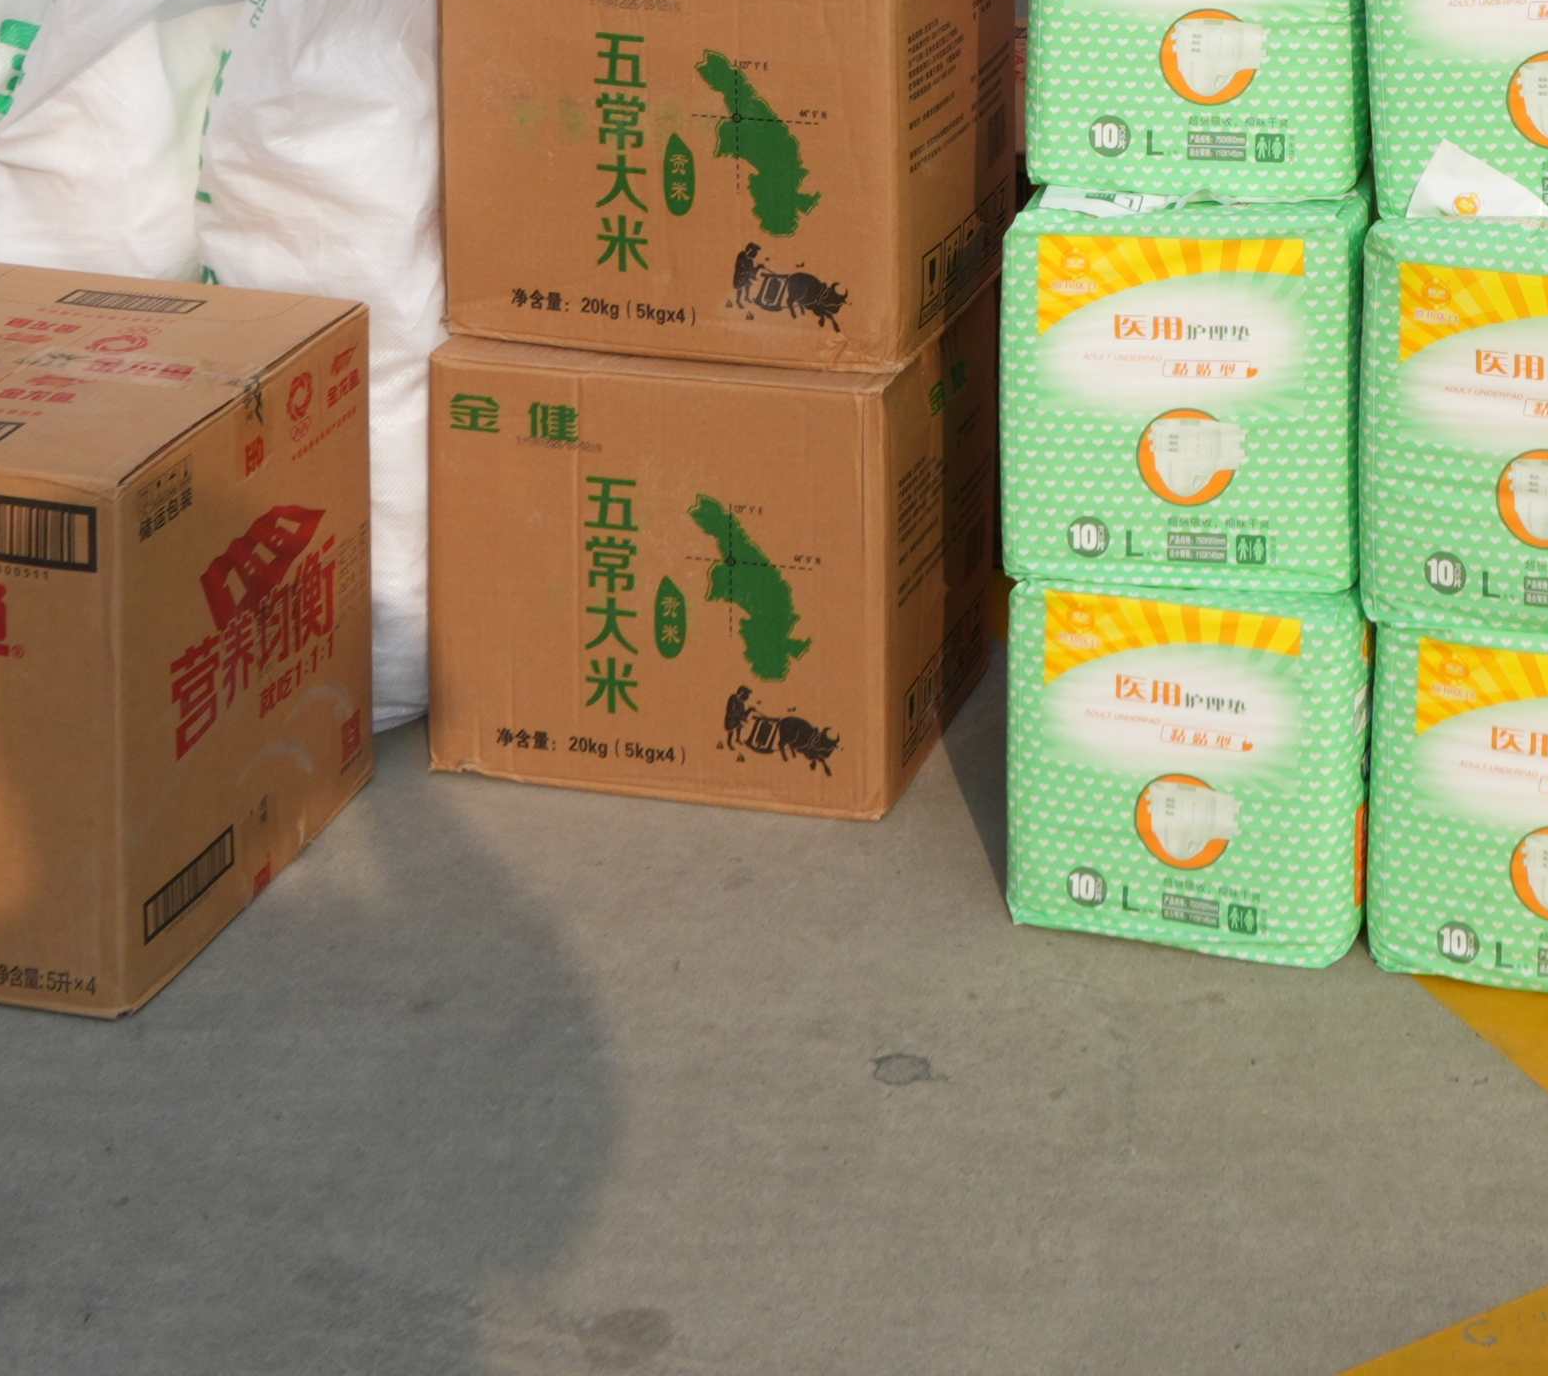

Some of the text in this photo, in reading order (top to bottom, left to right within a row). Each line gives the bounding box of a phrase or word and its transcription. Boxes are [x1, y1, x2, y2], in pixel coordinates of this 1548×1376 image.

[594, 31, 648, 272] 五常大米
[1147, 131, 1162, 155] L
[669, 153, 690, 201] 贡米
[581, 298, 620, 320] 20kg
[1114, 315, 1250, 340] 医用护理垫
[449, 393, 579, 442] 金健
[1126, 531, 1143, 555] L
[584, 475, 639, 714] 五常大米
[1483, 572, 1500, 597] L
[660, 595, 680, 644] 贡米
[170, 534, 336, 760] 营养均衡
[259, 636, 335, 720] 就吃1:1:1
[1115, 674, 1246, 713] 医用护理垫
[568, 736, 608, 759] 20kg
[1122, 886, 1140, 911] L
[1495, 942, 1513, 969] L
